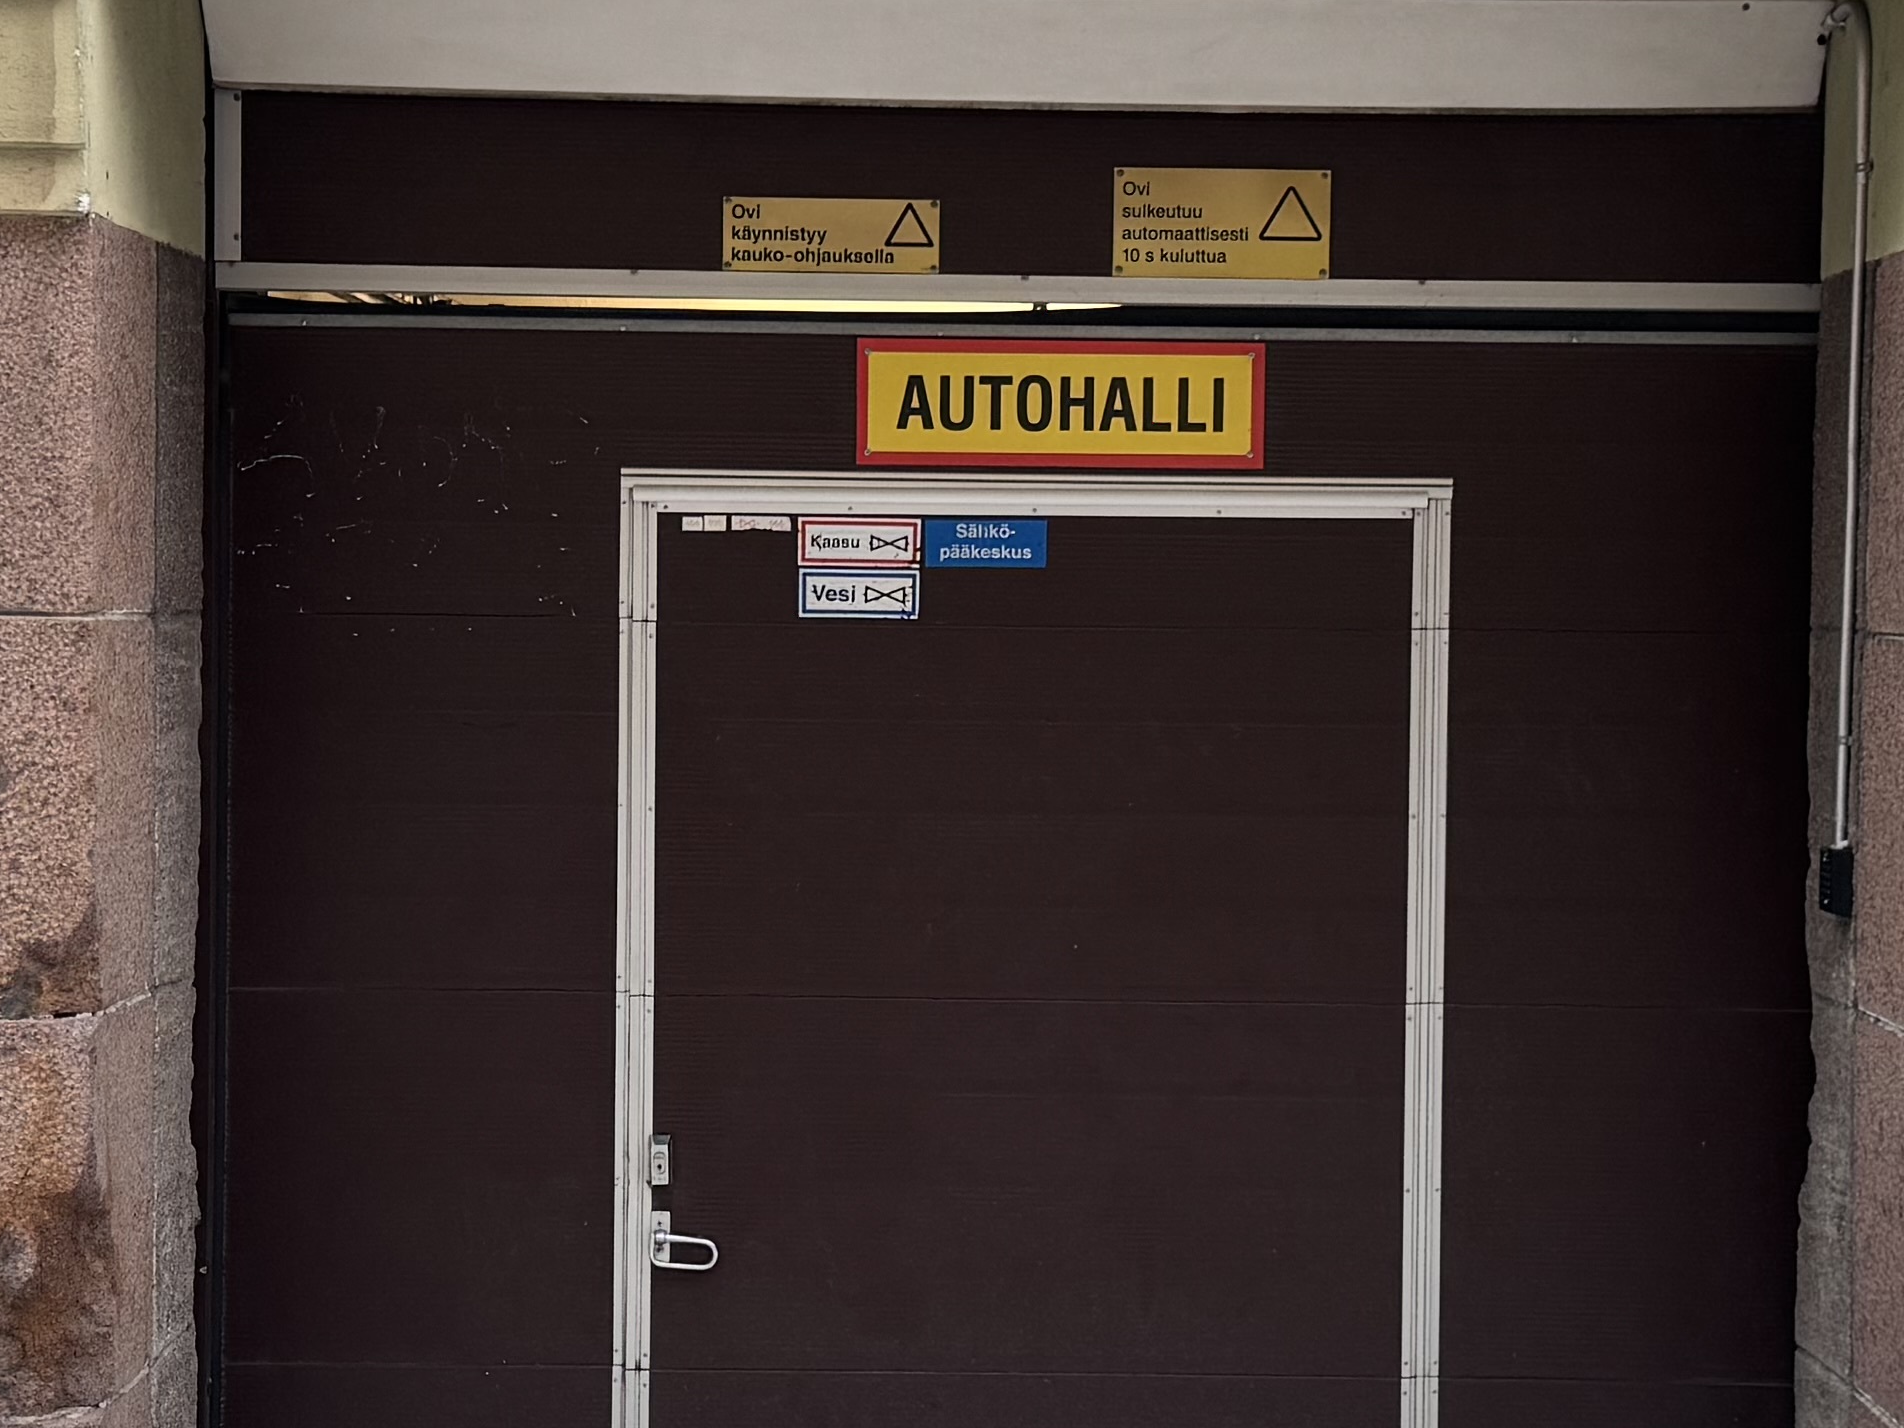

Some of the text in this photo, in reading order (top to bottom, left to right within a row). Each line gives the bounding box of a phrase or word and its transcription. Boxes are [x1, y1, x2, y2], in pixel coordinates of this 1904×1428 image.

[1123, 181, 1150, 196] Ovi
[732, 204, 760, 219] Ovi
[1122, 204, 1203, 219] sulkeutuu
[732, 225, 827, 245] käynnistyy
[1122, 227, 1249, 242] automaattisesti
[1123, 248, 1227, 264] 10 s kuluttua
[896, 375, 1224, 433] AUTOHALLI
[940, 545, 1032, 562] pääkeskus
[811, 584, 856, 604] Vesi
